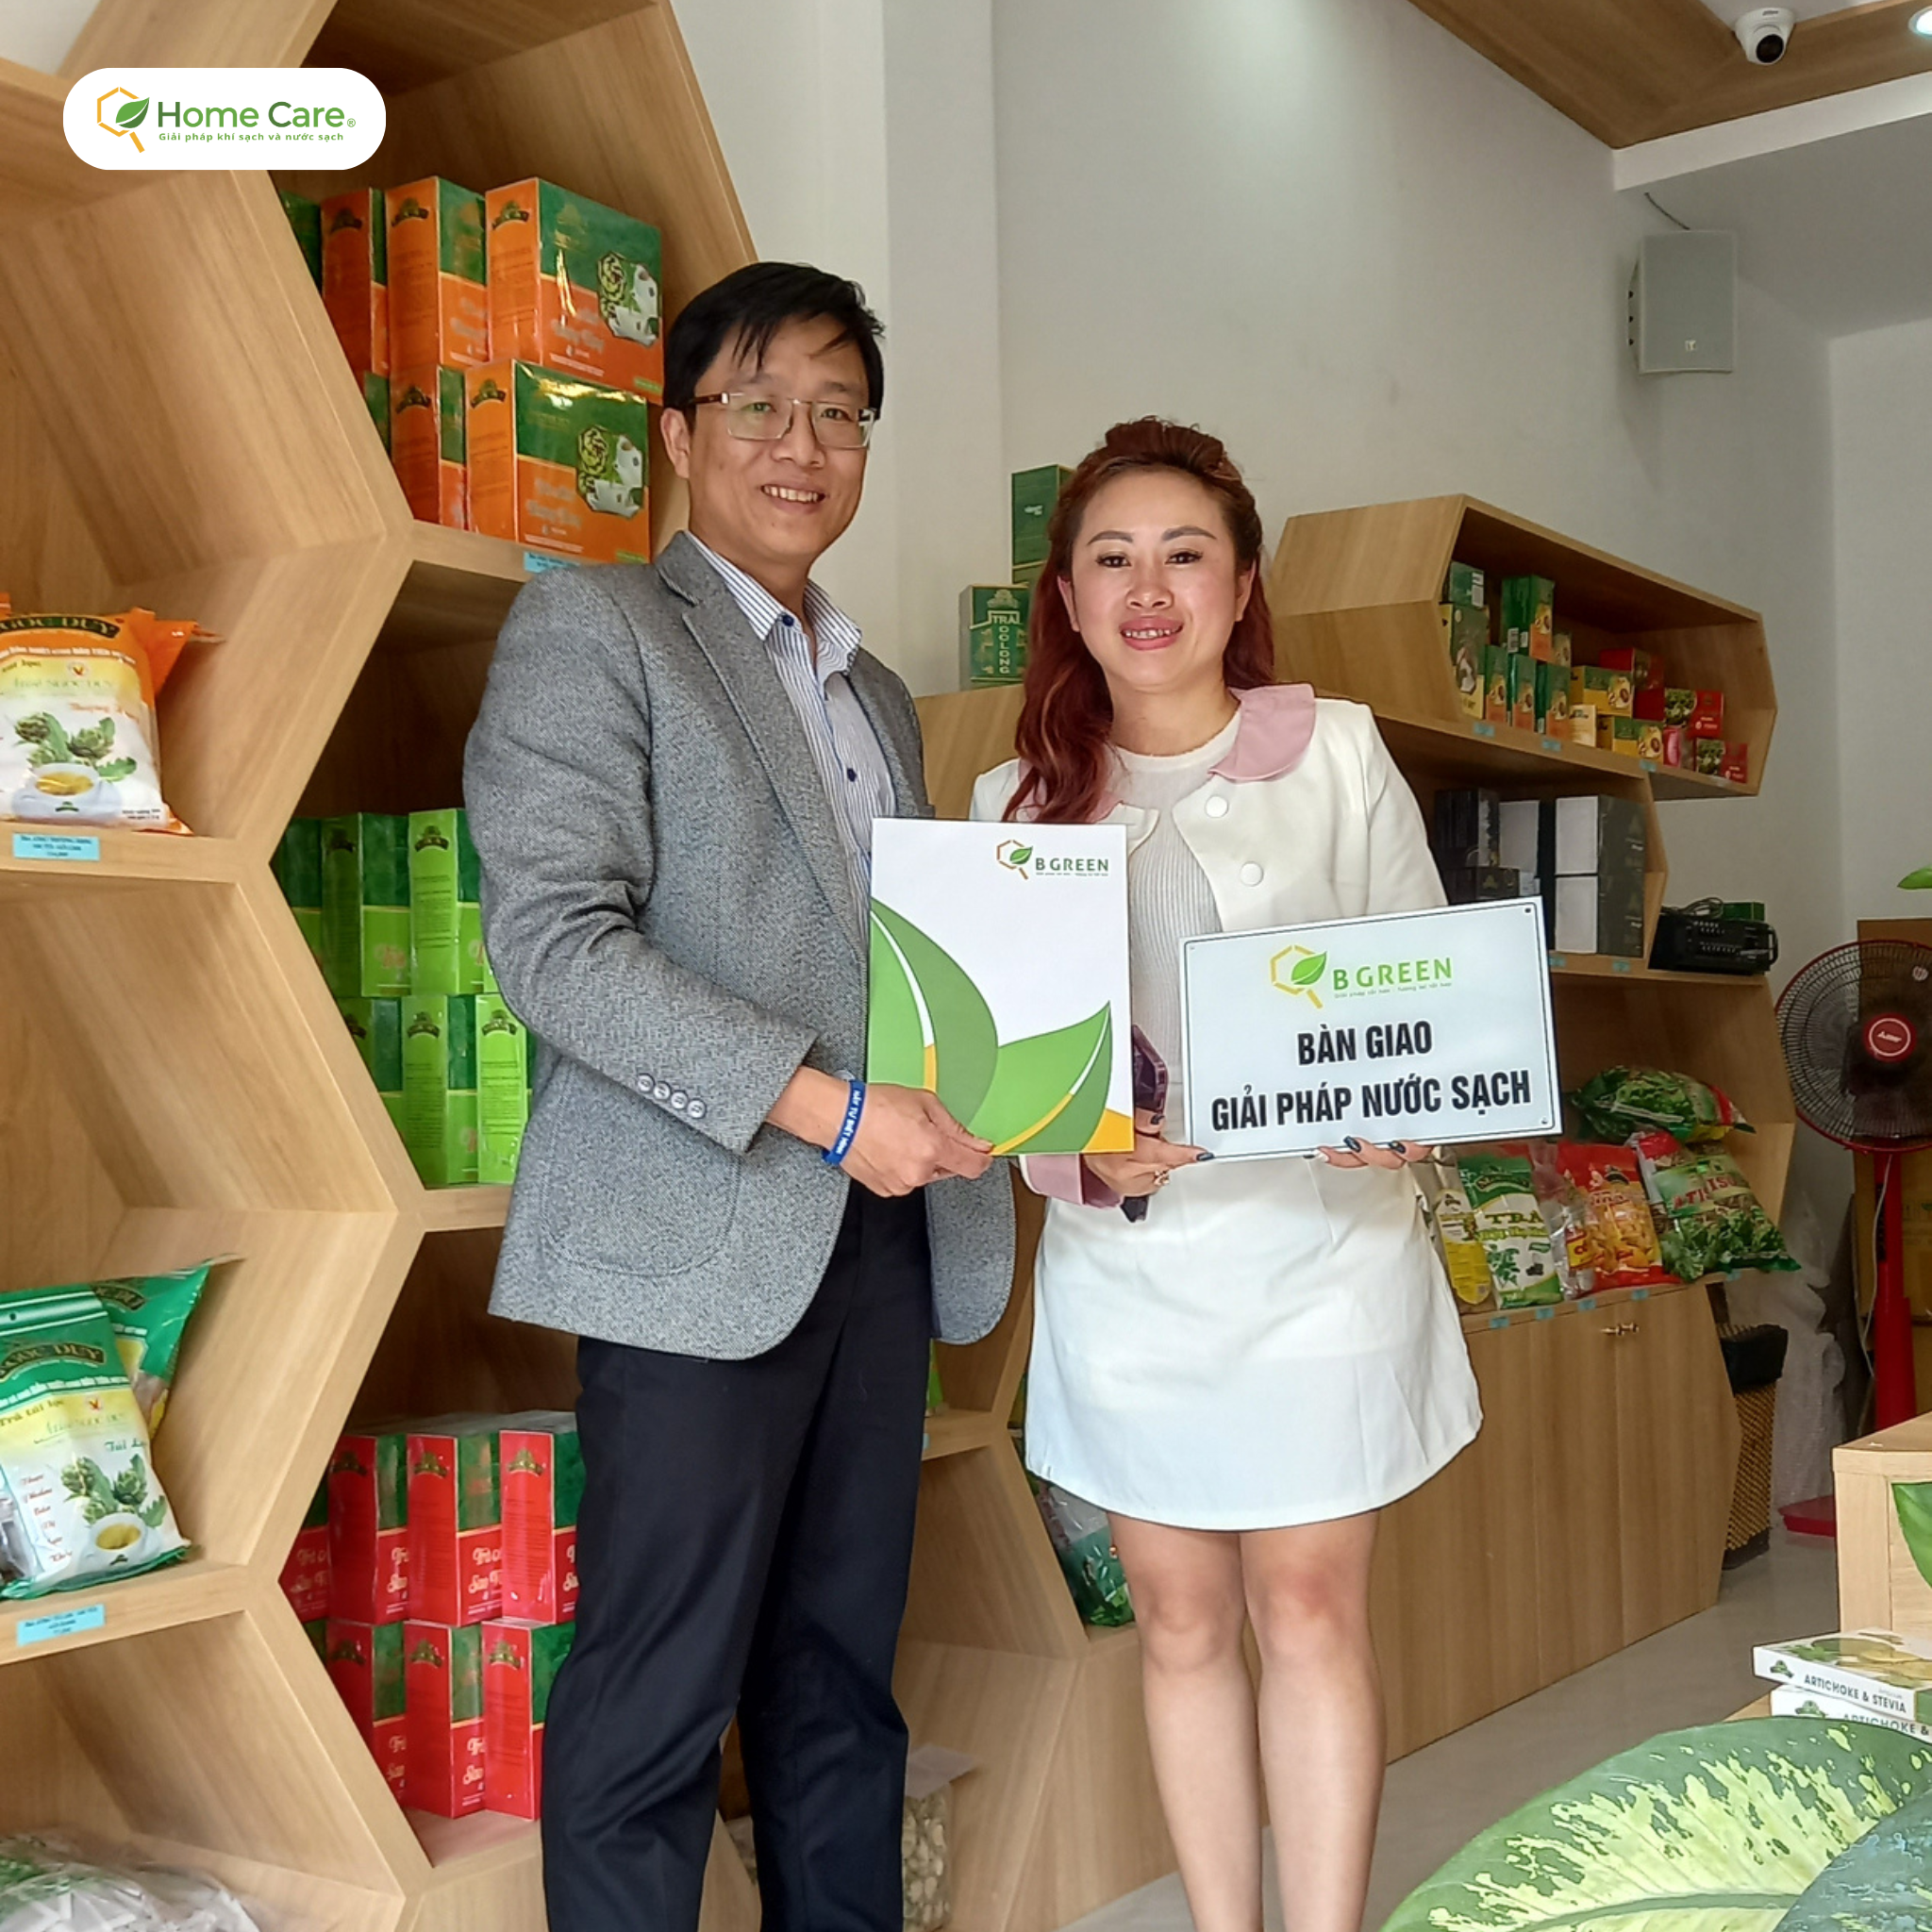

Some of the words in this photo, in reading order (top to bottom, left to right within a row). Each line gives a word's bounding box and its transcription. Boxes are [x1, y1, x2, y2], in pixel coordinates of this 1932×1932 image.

[1297, 1024, 1357, 1065] BÀN
[1366, 1021, 1432, 1058] GIAO
[1211, 1084, 1267, 1131] GIẢI
[1276, 1081, 1352, 1125] PHÁP
[1361, 1073, 1441, 1118] NƯỚC
[1451, 1070, 1531, 1115] SẠCH
[1804, 1674, 1859, 1700] ARTICHOKE
[1862, 1690, 1869, 1703] &
[1872, 1693, 1907, 1713] STEVIA
[1920, 1724, 1929, 1737] &
